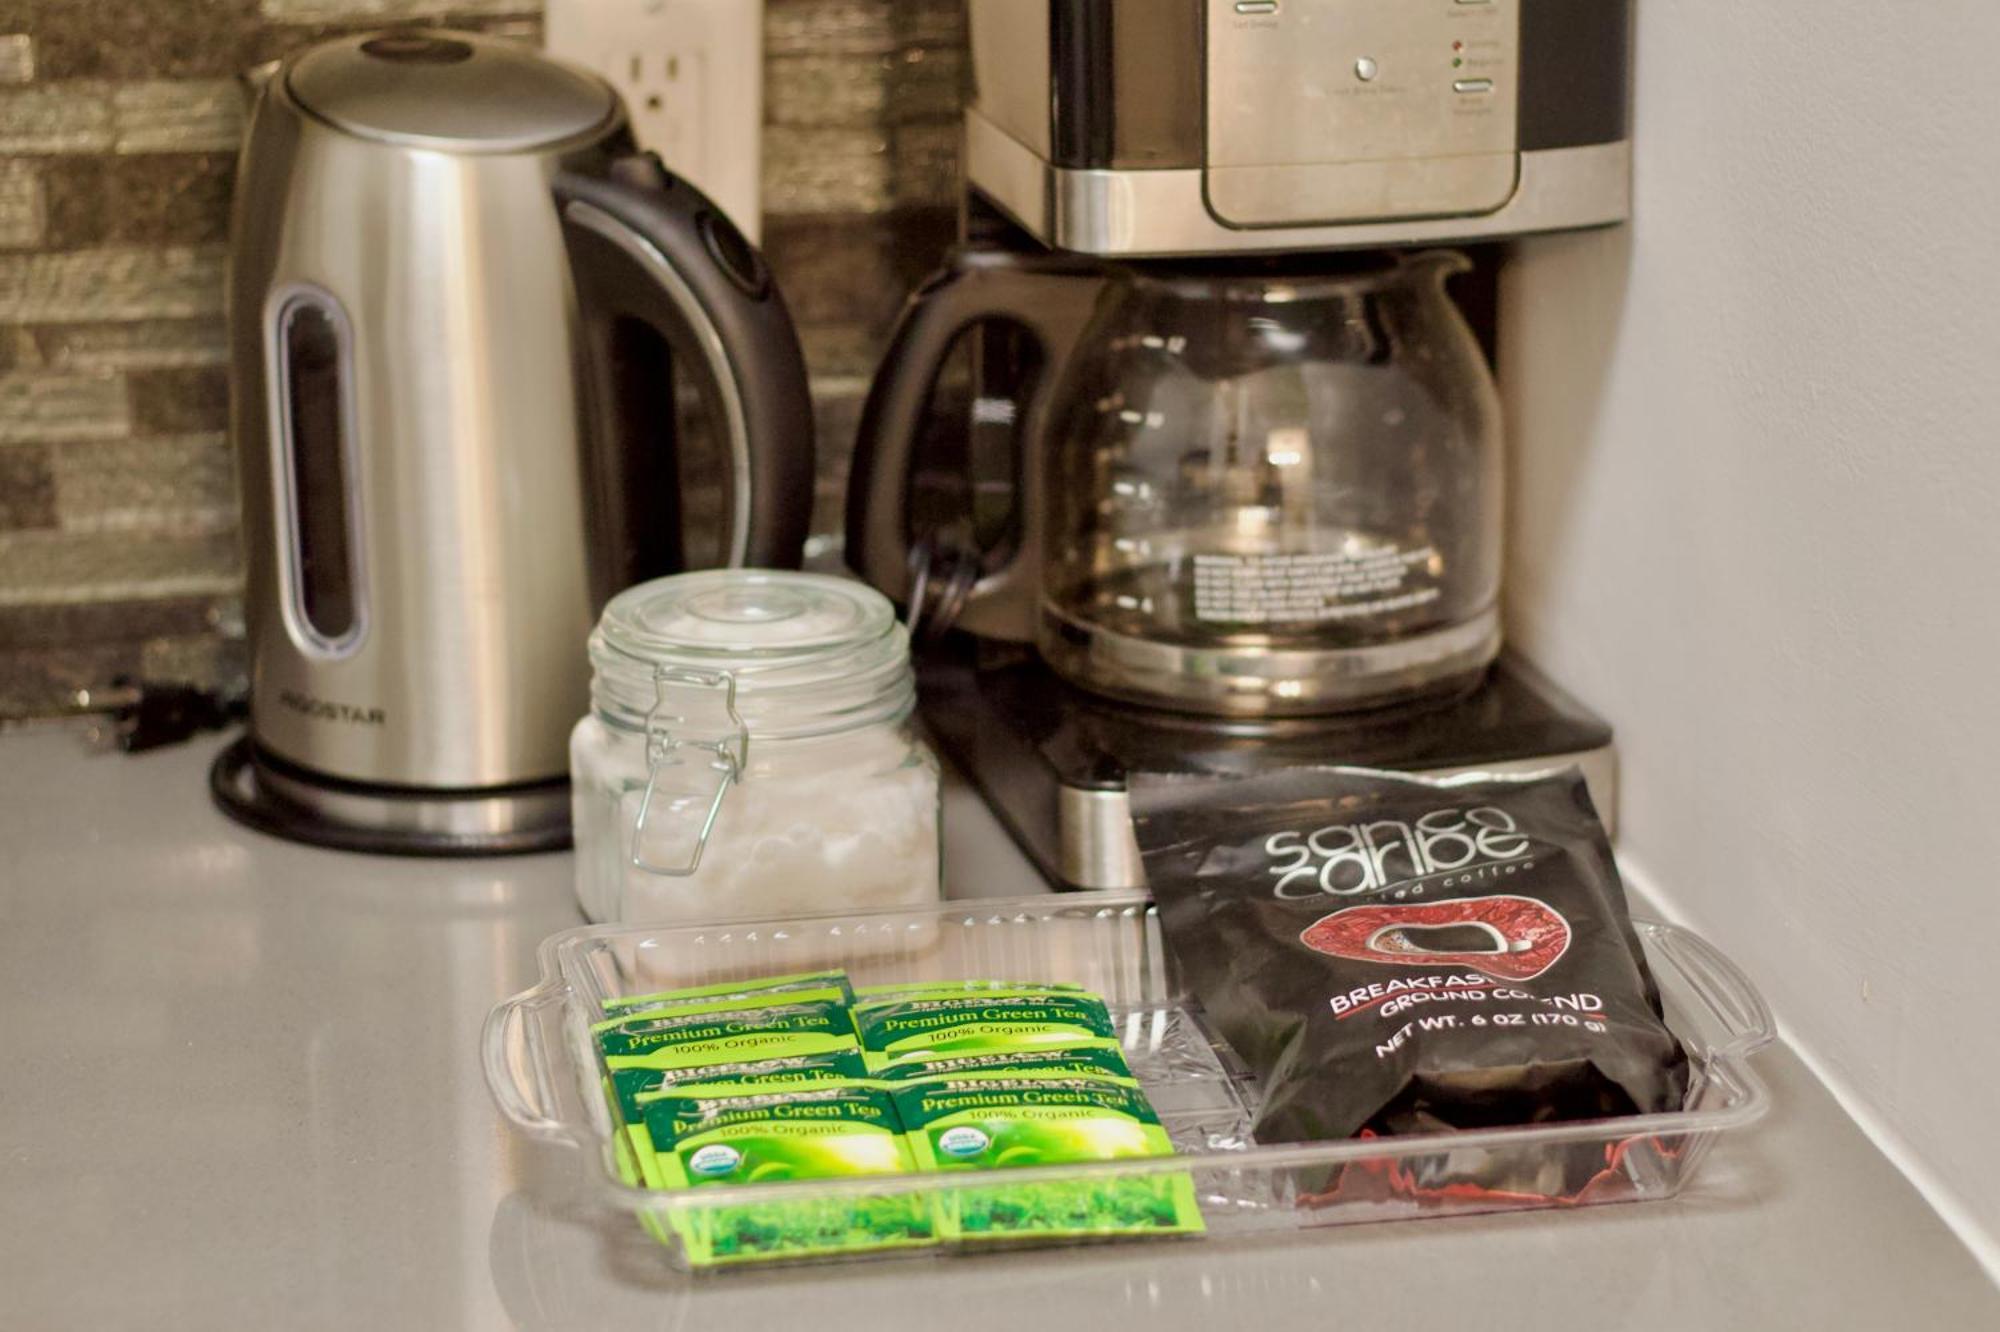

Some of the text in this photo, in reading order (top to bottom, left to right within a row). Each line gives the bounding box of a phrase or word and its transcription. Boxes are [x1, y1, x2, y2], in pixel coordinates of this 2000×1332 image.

[1442, 862, 1535, 888] coffee
[1379, 990, 1486, 1017] GROUND
[886, 1007, 1087, 1032] Premium Green Tea
[629, 1016, 830, 1049] Premium Green Tea
[929, 1025, 1050, 1042] 100% Organic
[1375, 1022, 1413, 1058] NET
[1418, 1015, 1464, 1031] WT.
[1471, 1014, 1487, 1026] 6
[1492, 1013, 1526, 1025] OZ
[1531, 1013, 1579, 1026] (170
[674, 1034, 797, 1054] 100% Organic
[774, 1103, 841, 1118] Green
[844, 1102, 882, 1117] Tea
[921, 1093, 1018, 1112] Premium
[1023, 1091, 1090, 1104] Green
[968, 1109, 1099, 1120] 100% Organic
[720, 1124, 847, 1138] 100% Organic
